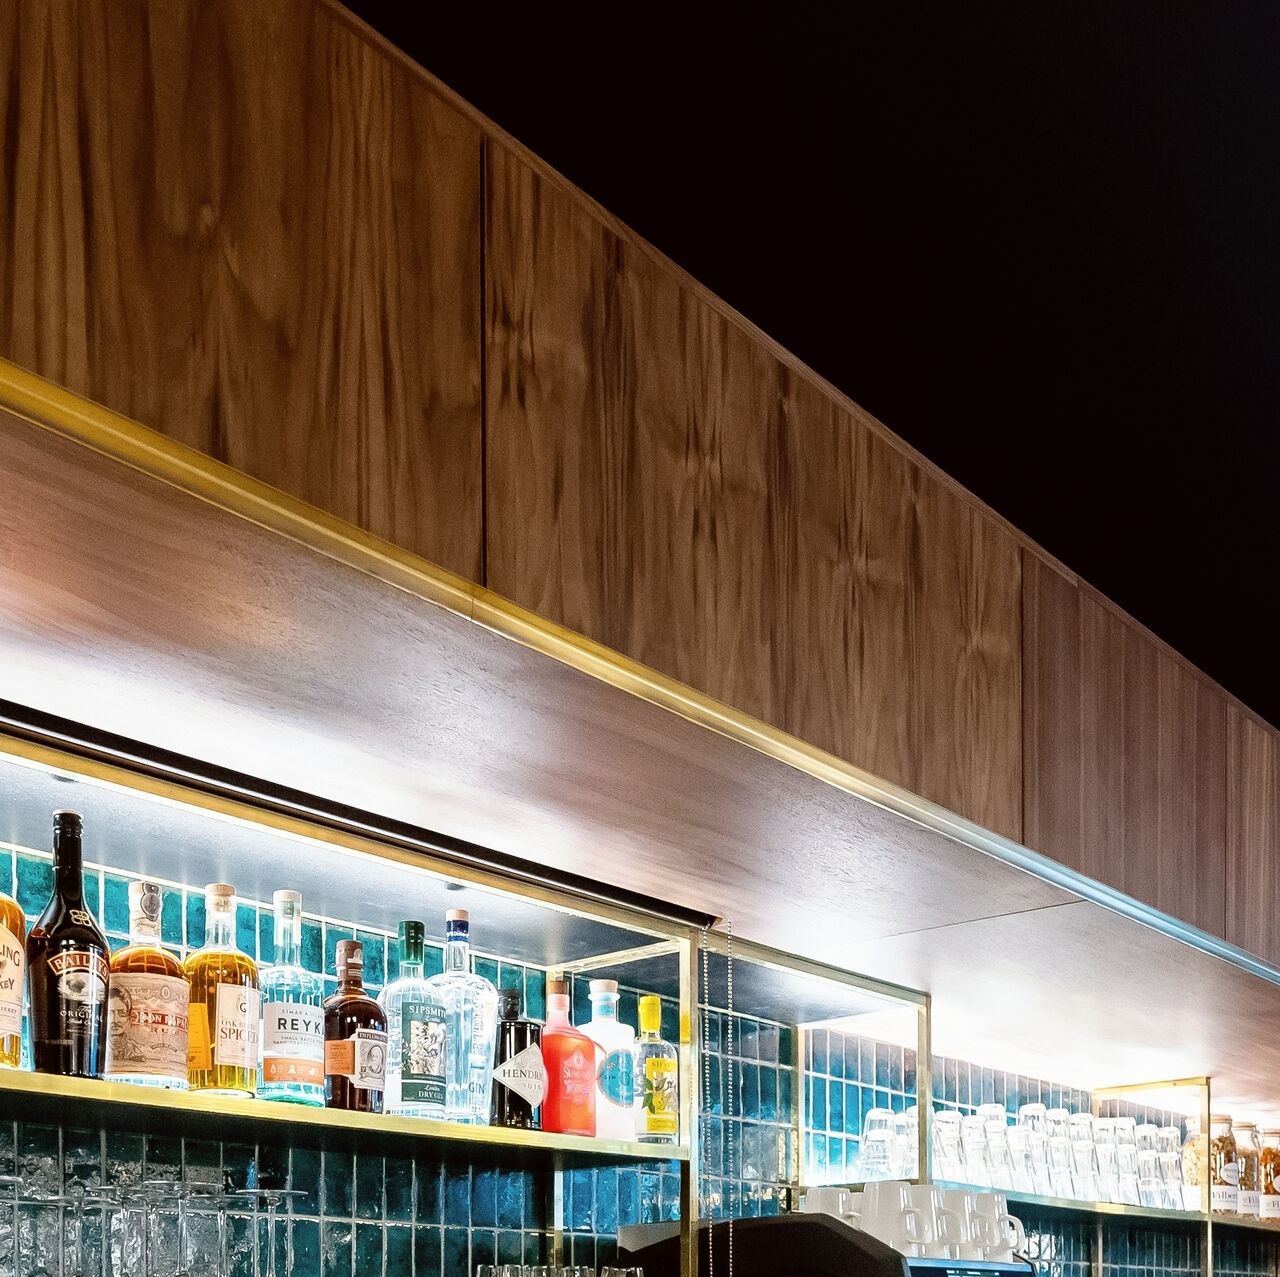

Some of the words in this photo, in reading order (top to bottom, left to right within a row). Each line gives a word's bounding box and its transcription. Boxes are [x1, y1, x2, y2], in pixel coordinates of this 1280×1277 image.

[53, 954, 108, 977] BAILYS
[418, 1090, 433, 1098] DRY
[469, 1081, 485, 1095] GIN
